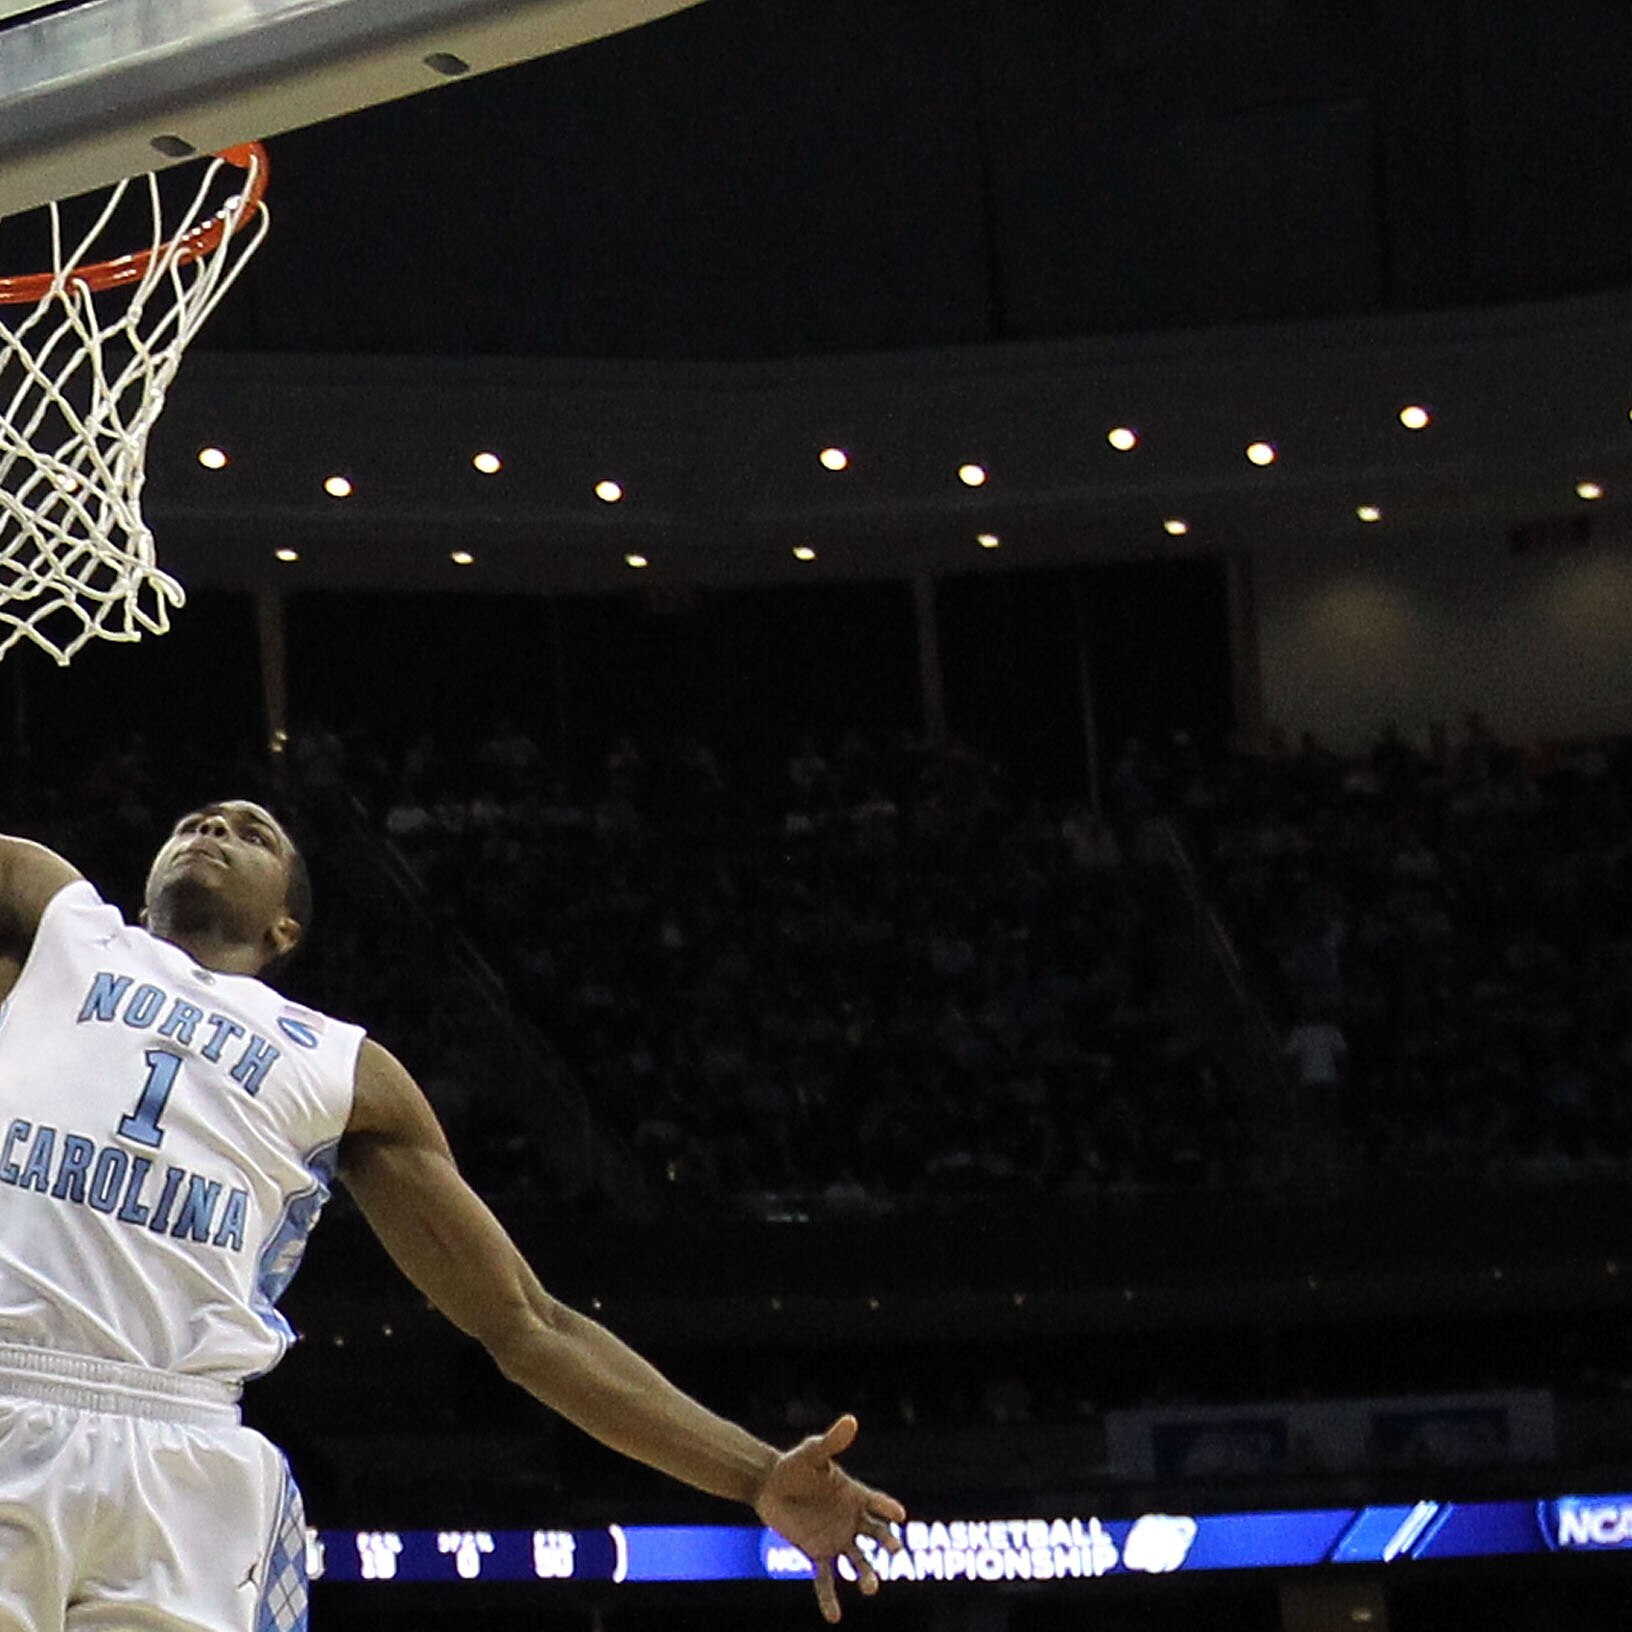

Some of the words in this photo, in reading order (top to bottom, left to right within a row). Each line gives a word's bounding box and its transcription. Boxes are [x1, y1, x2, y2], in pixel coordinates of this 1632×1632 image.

[76, 971, 282, 1097] NORTH
[117, 1049, 186, 1148] 1
[906, 1517, 1112, 1552] BASKETBALL
